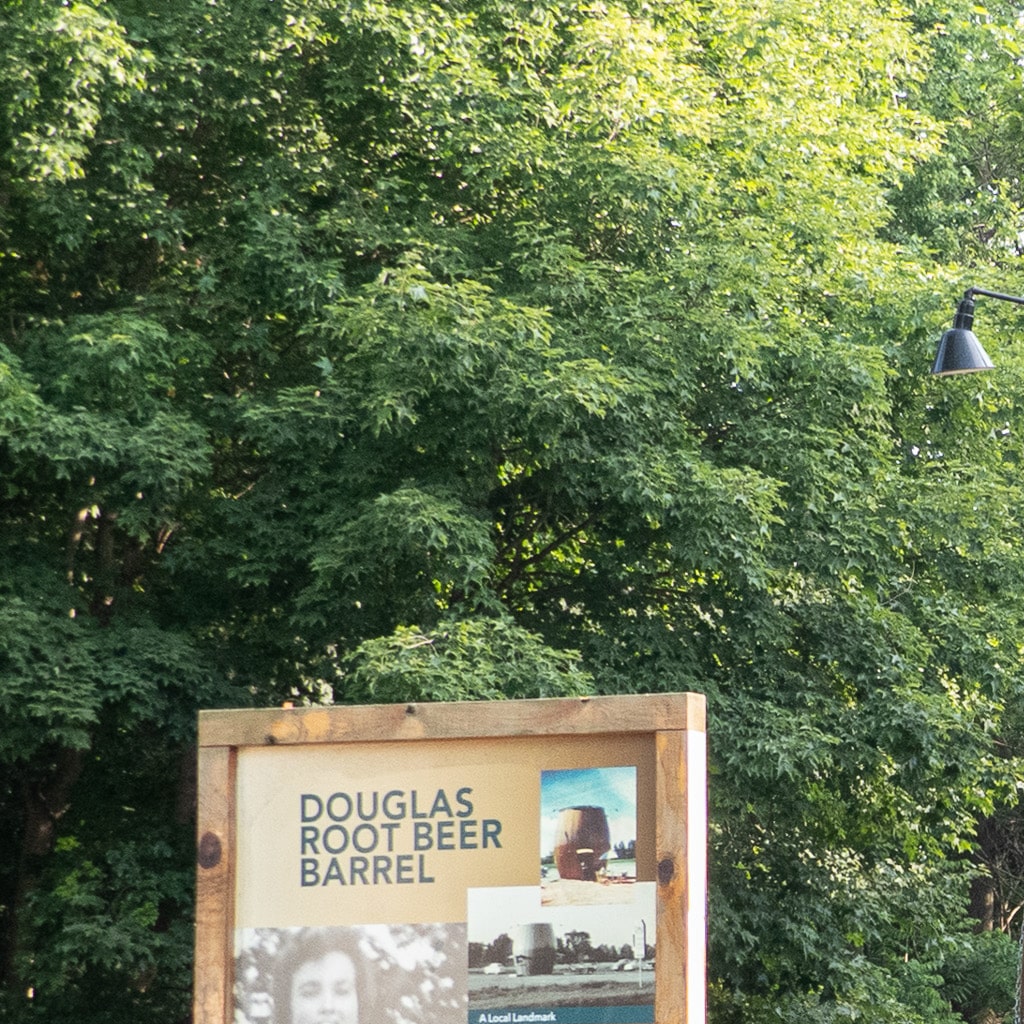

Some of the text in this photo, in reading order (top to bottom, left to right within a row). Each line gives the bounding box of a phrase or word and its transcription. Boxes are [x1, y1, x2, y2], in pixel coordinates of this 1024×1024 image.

[300, 787, 474, 823] DOUGLAS
[300, 819, 503, 855] ROOT BEER
[300, 854, 435, 887] BARREL
[479, 1011, 557, 1023] A Local Landmark
